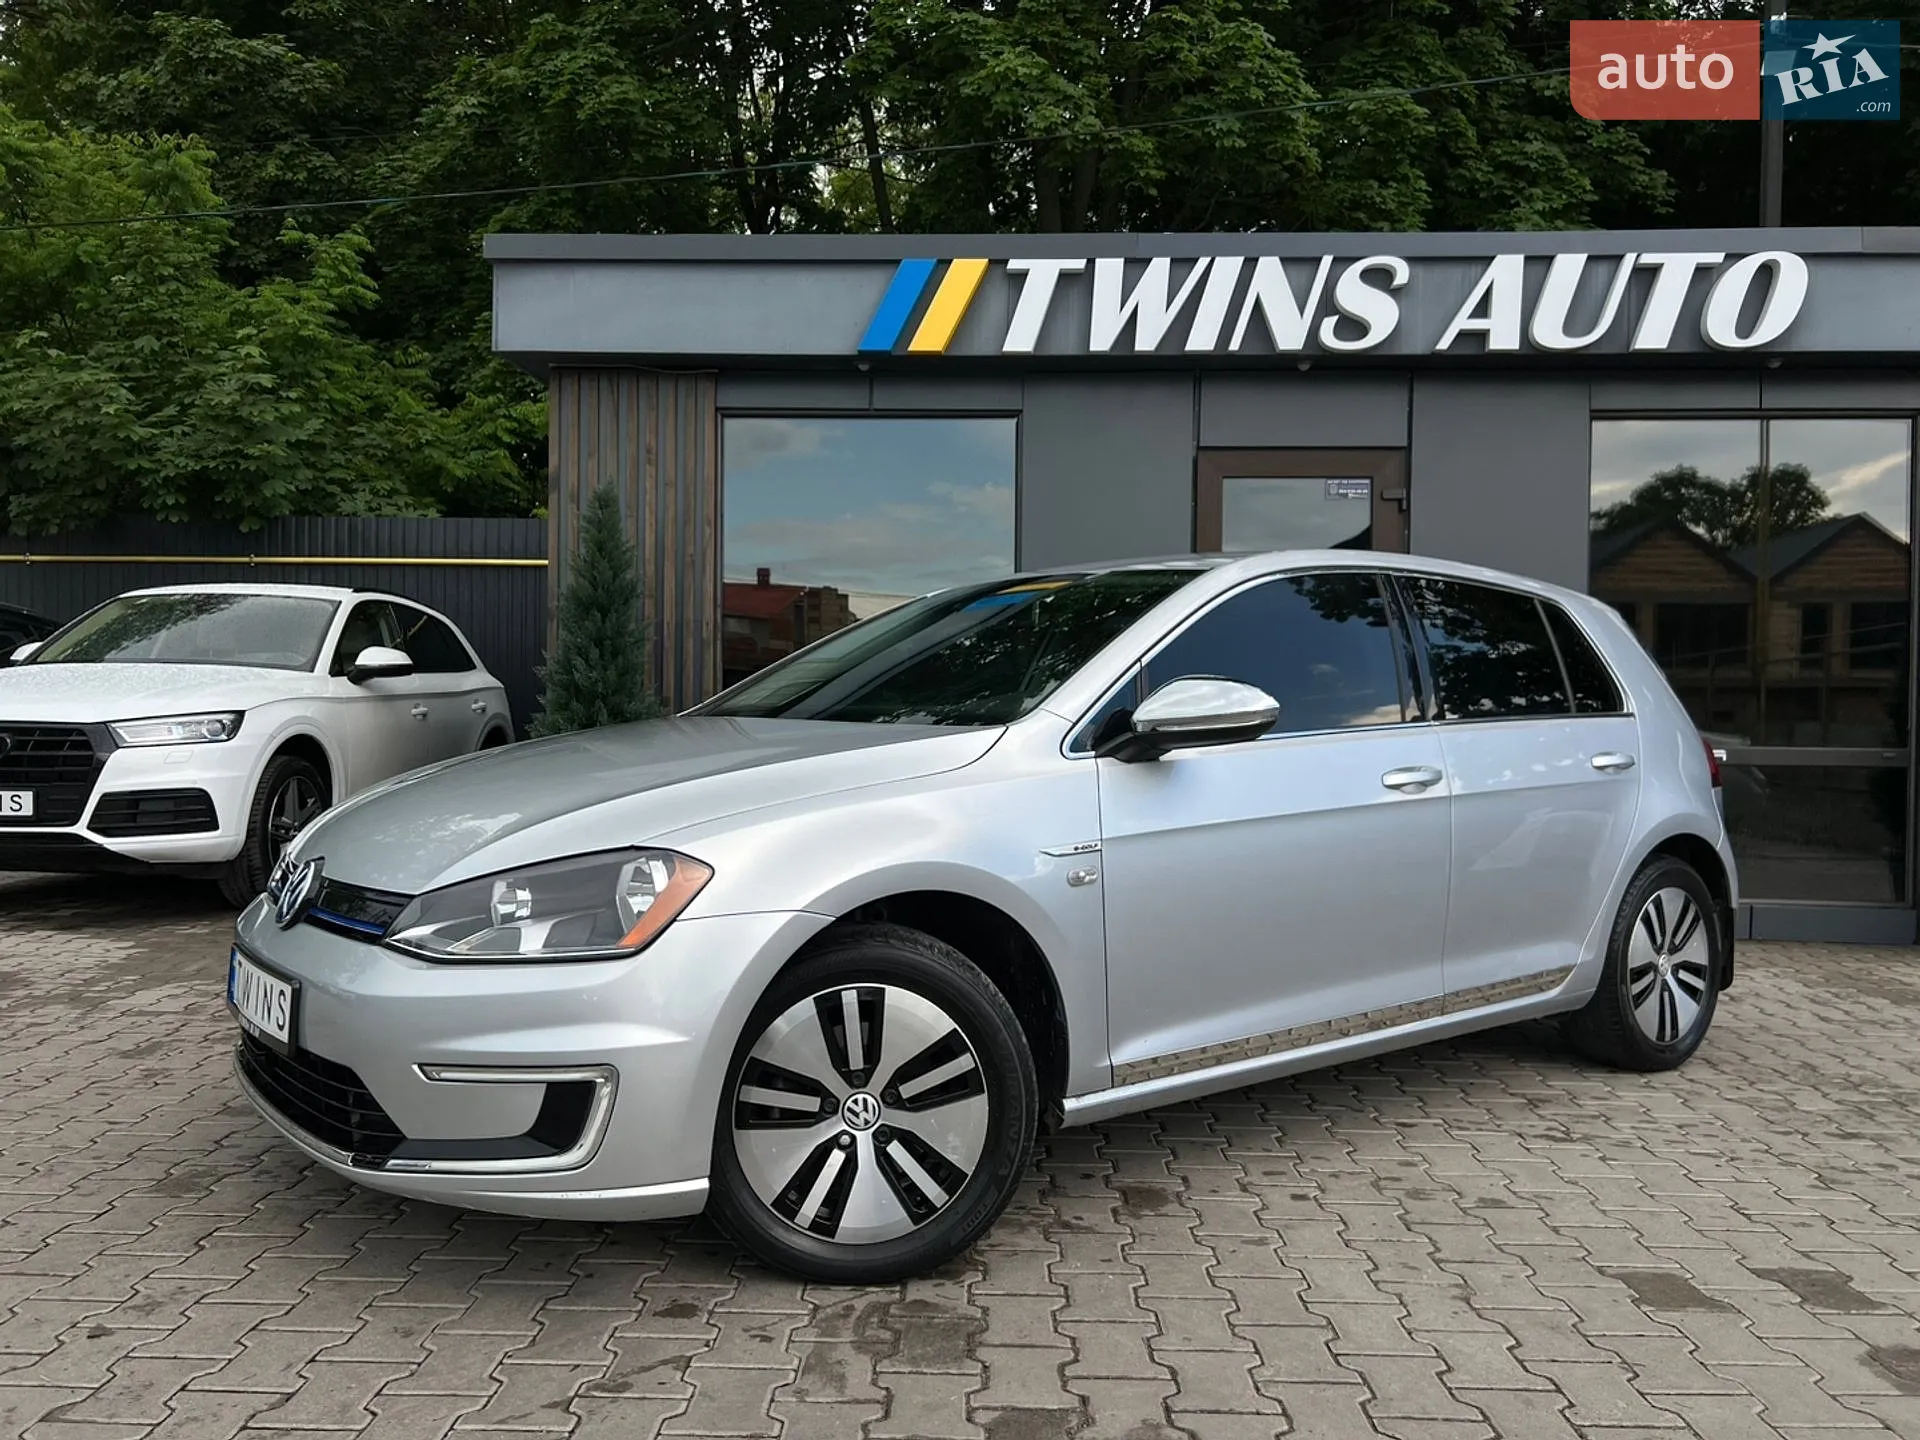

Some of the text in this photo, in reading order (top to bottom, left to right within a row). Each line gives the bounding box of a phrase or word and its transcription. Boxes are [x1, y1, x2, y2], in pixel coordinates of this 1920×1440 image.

[1002, 250, 1809, 353] TWINS AUTO
[0, 794, 23, 812] S
